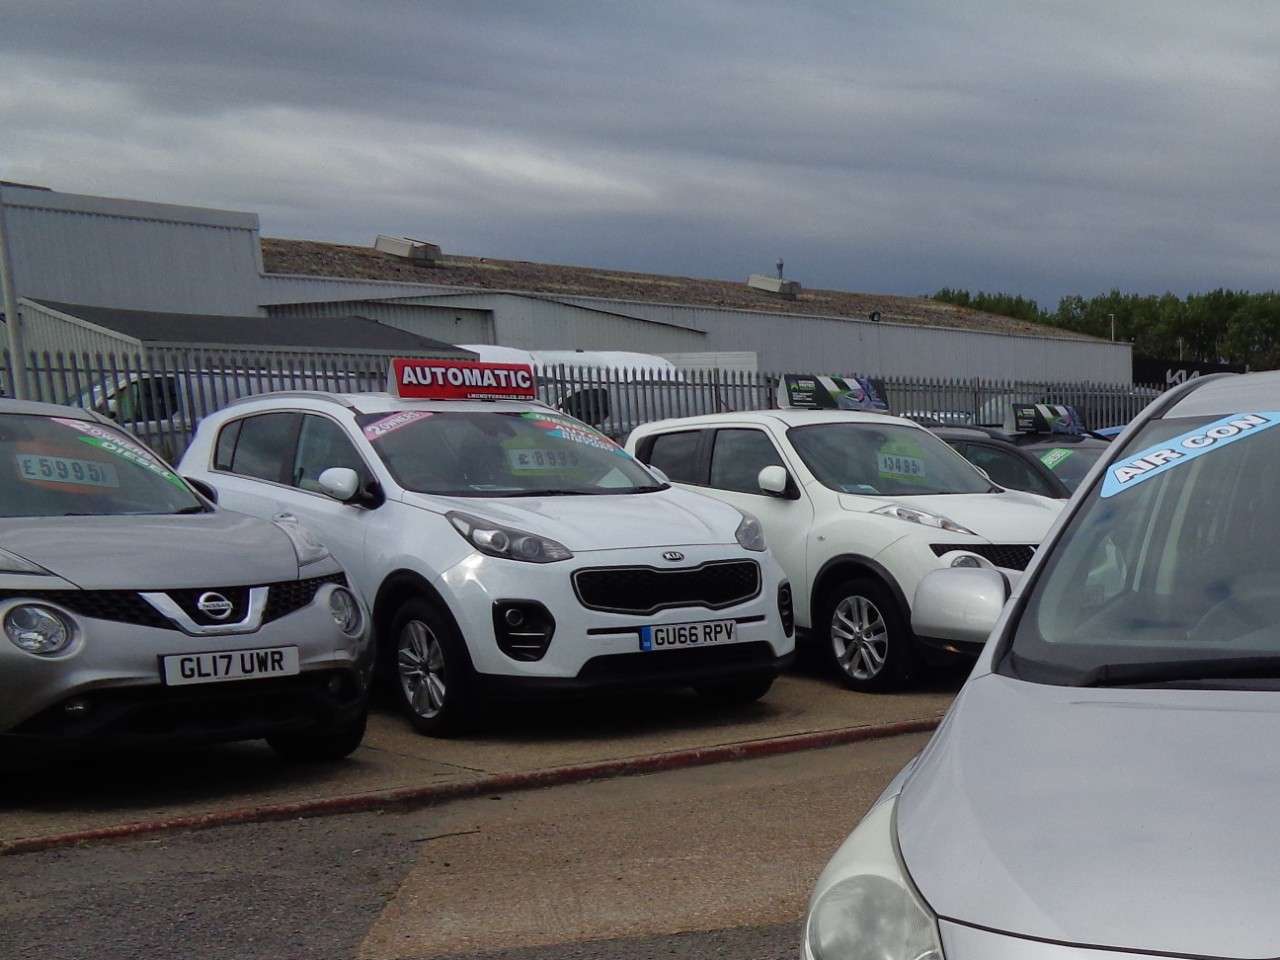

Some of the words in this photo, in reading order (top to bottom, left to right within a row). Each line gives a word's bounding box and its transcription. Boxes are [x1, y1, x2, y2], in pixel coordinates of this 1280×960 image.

[402, 366, 531, 388] AUTOMATIC
[1113, 448, 1186, 485] AIR
[1181, 413, 1271, 449] CON
[664, 552, 682, 560] KIA
[654, 625, 699, 646] GU66
[703, 622, 734, 642] RPV
[180, 654, 233, 679] GL17
[240, 650, 284, 674] UWR
